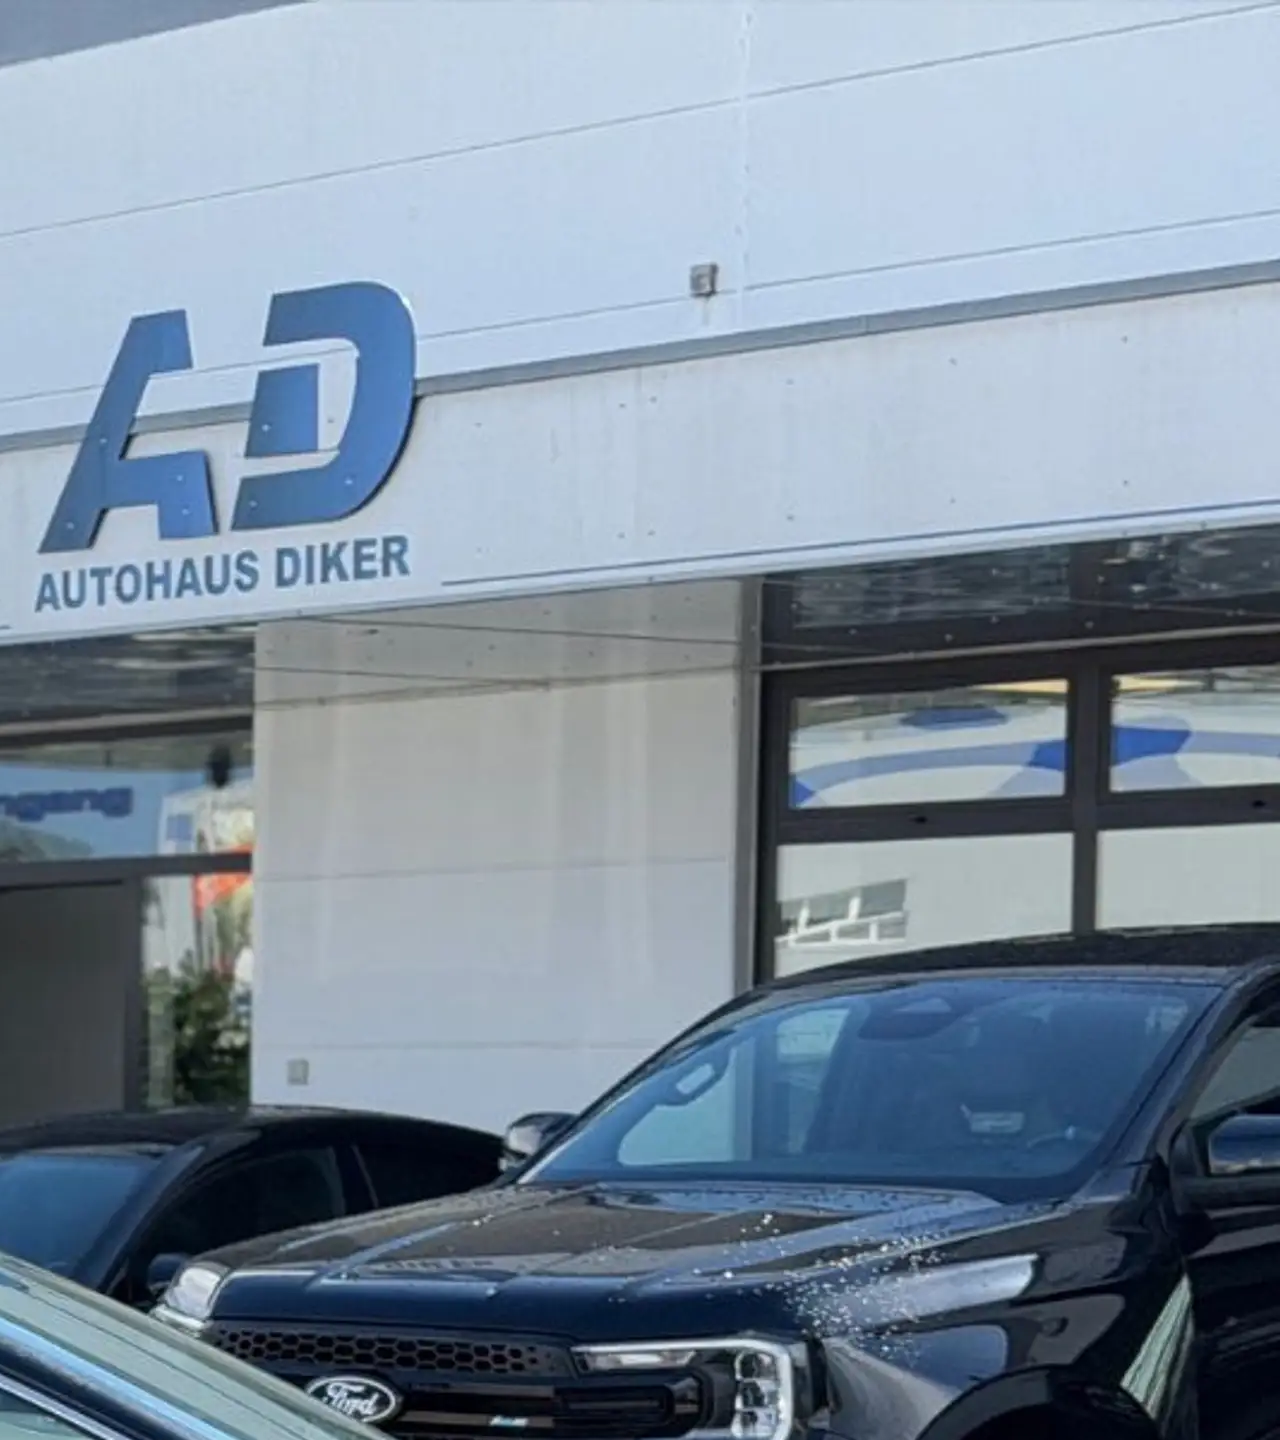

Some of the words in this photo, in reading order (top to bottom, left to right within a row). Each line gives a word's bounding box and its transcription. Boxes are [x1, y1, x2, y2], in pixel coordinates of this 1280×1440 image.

[37, 281, 417, 554] AD
[35, 549, 260, 613] AUTOHAUS
[274, 534, 411, 588] DIKER
[322, 1382, 380, 1416] Ford
